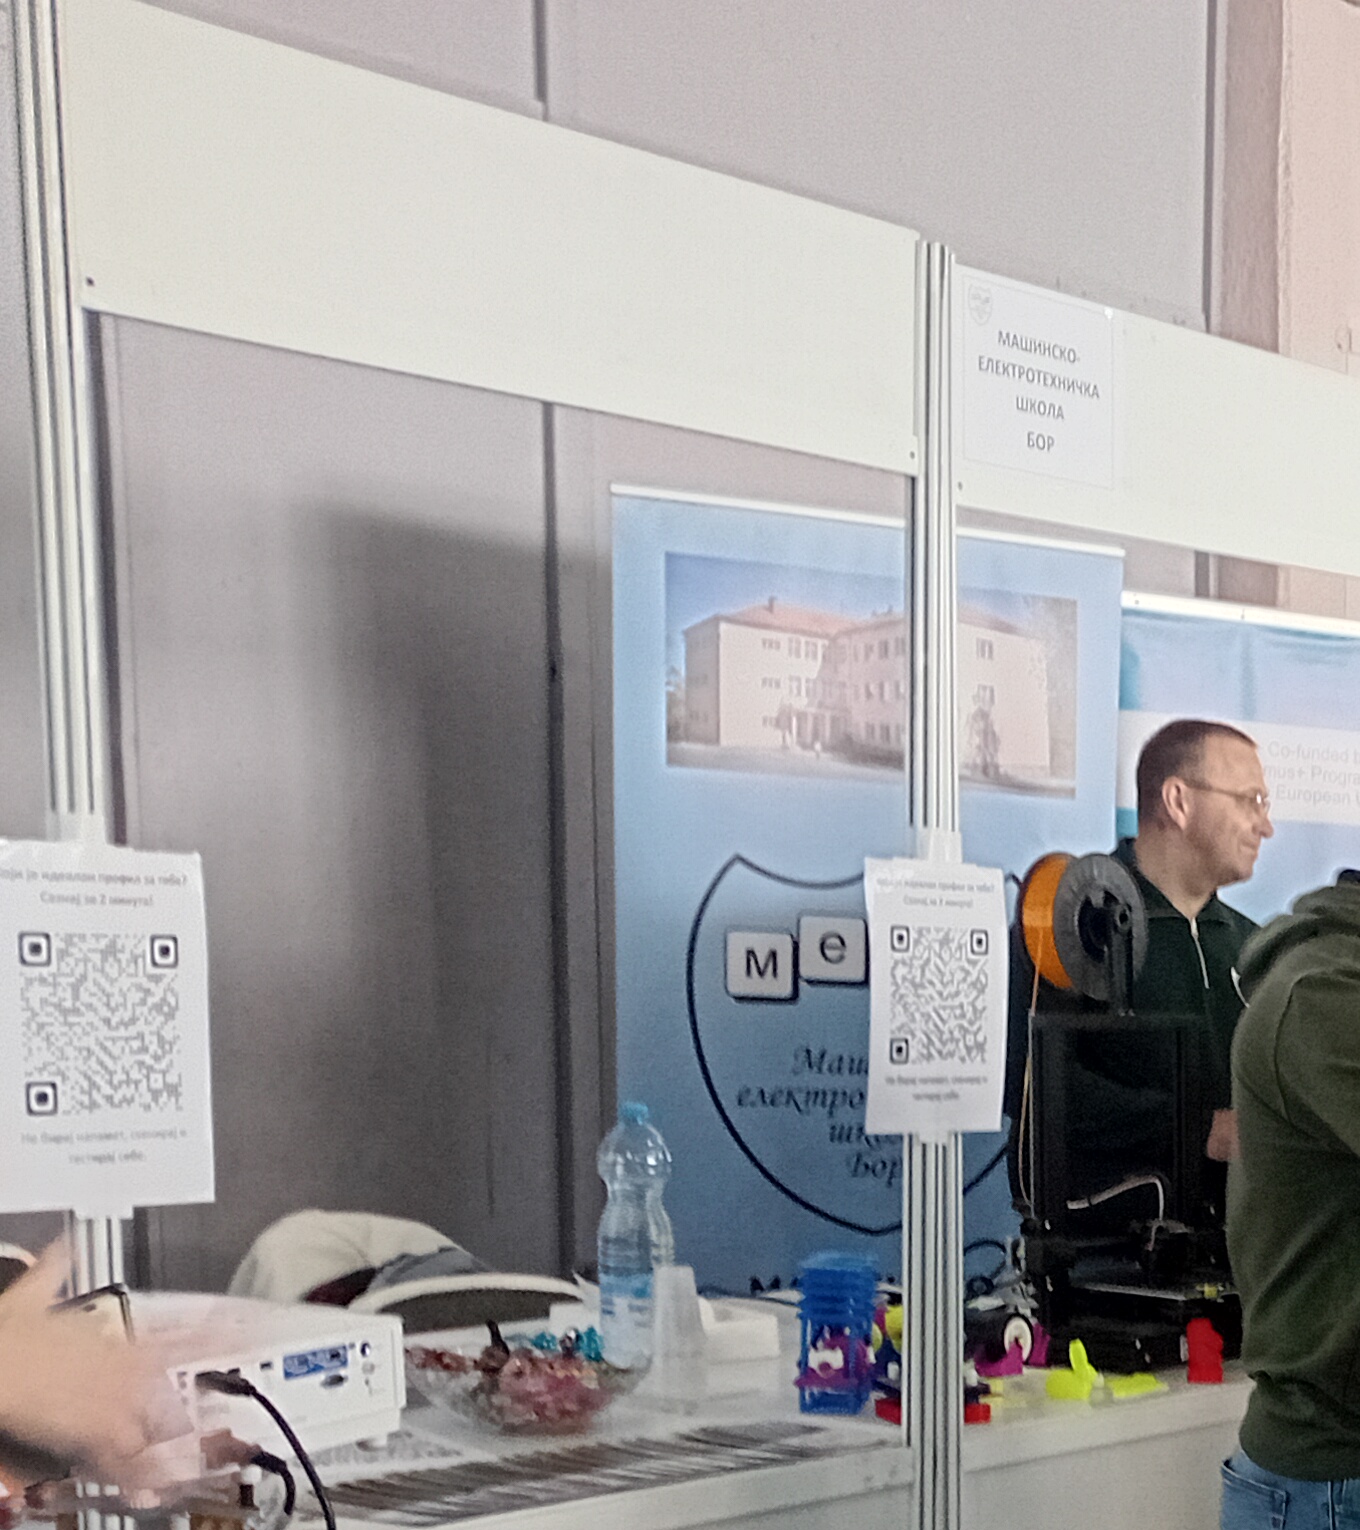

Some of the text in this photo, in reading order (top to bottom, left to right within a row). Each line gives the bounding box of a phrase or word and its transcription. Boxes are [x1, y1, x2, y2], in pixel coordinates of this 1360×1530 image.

[978, 355, 1100, 399] ЕЛЕКТРОТЕХНИЧКА
[1016, 396, 1064, 421] ШКОЛА
[1026, 431, 1055, 452] БОР
[1275, 784, 1351, 807] European
